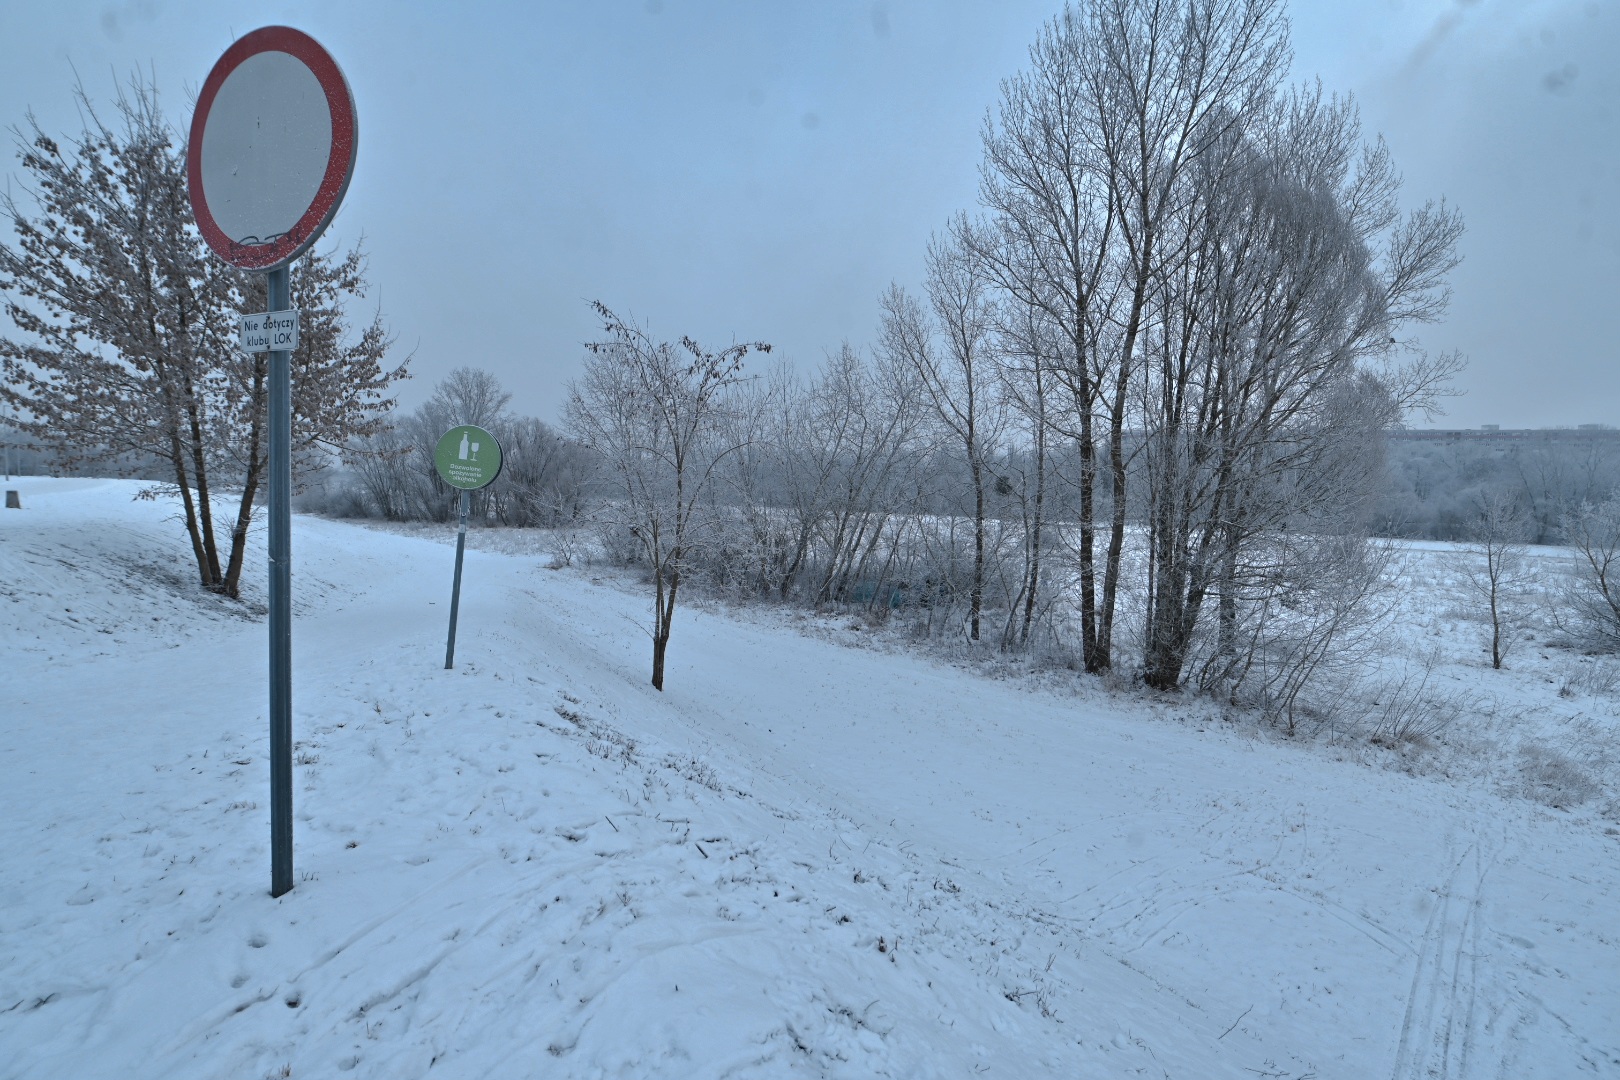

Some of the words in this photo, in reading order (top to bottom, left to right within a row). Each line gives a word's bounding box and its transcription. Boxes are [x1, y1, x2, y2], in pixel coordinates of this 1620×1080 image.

[244, 320, 259, 332] Nie
[262, 318, 295, 332] dotyczy
[246, 335, 270, 347] klubu
[274, 332, 292, 345] LOK
